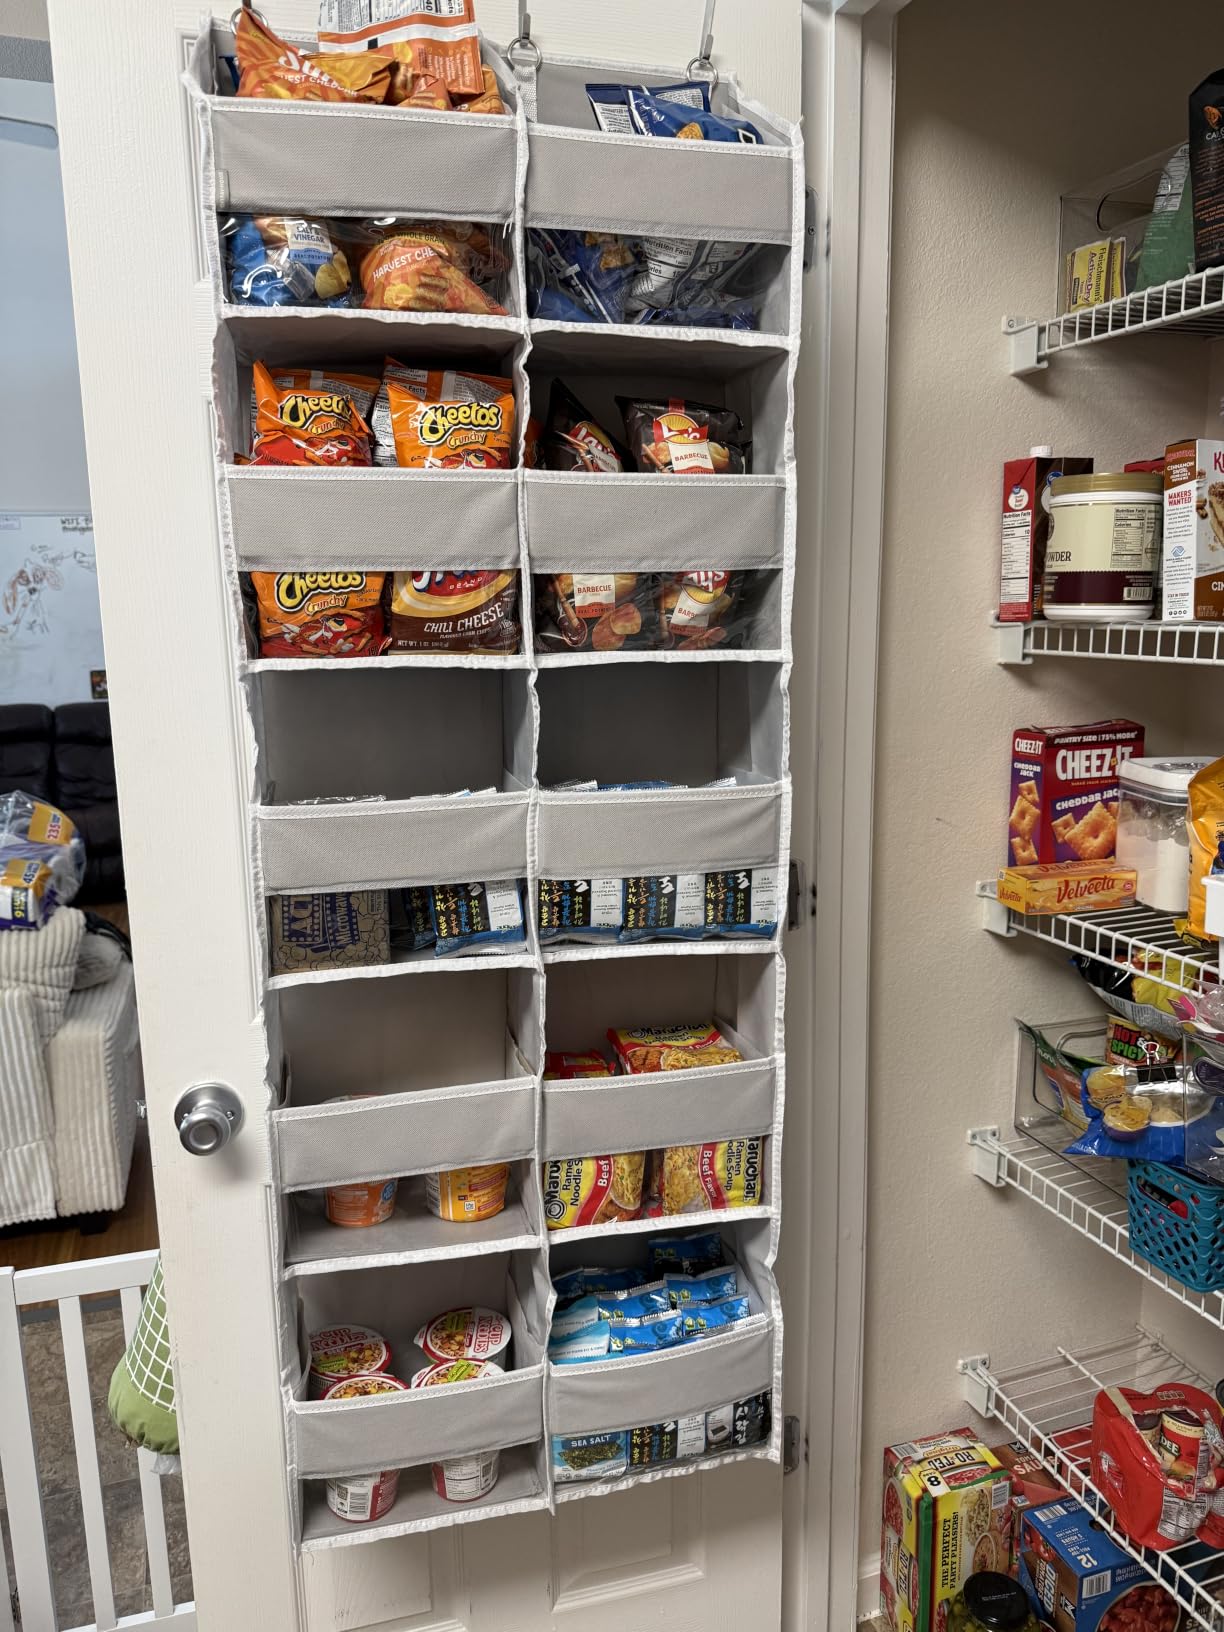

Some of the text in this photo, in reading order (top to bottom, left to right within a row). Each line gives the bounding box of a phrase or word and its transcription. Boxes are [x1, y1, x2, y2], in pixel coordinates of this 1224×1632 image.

[294, 233, 325, 244] VINEGAR
[675, 246, 692, 257] Facts
[372, 253, 413, 283] HARVEST
[1082, 252, 1097, 303] Active Dry
[1095, 247, 1107, 302] Fleischmann's
[408, 385, 426, 394] Facts
[421, 402, 500, 443] Cheetos
[447, 431, 487, 449] Crunchy
[674, 453, 709, 462] BARBECUE
[1167, 461, 1195, 471] CINNAMON
[1168, 489, 1192, 500] MAKERS
[1168, 496, 1192, 507] WANTED
[278, 571, 363, 606] Cheetos
[449, 576, 483, 590] BRAND
[577, 584, 612, 594] BARBECUE
[304, 594, 348, 616] Crunchy
[424, 621, 453, 633] CHILI
[456, 602, 505, 632] CHEESE
[1101, 733, 1116, 741] 75%
[1103, 788, 1120, 799] JAC
[47, 824, 60, 839] 235
[23, 872, 35, 884] 45
[1000, 887, 1021, 902] Velveeta
[1056, 875, 1115, 904] Velveeta
[640, 1023, 708, 1035] Maruchan
[1113, 1024, 1141, 1046] HOT
[1111, 1039, 1147, 1060] SPICY
[703, 1150, 713, 1175] Beef
[735, 1141, 744, 1175] Ramen
[598, 1160, 609, 1187] Beef
[724, 1165, 734, 1191] Soup
[570, 1168, 582, 1206] Noodle
[474, 1315, 492, 1353] NOODLES
[489, 1323, 503, 1345] CUP
[571, 1434, 611, 1447] SEA SALT
[1013, 1456, 1060, 1474] SAUE
[927, 1475, 942, 1487] 8
[942, 1518, 951, 1567] PERFECT
[950, 1511, 959, 1559] PLEASERS!
[1077, 1553, 1098, 1568] 12
[1037, 1559, 1047, 1600] TOMATOES
[1044, 1564, 1056, 1612] DICED
